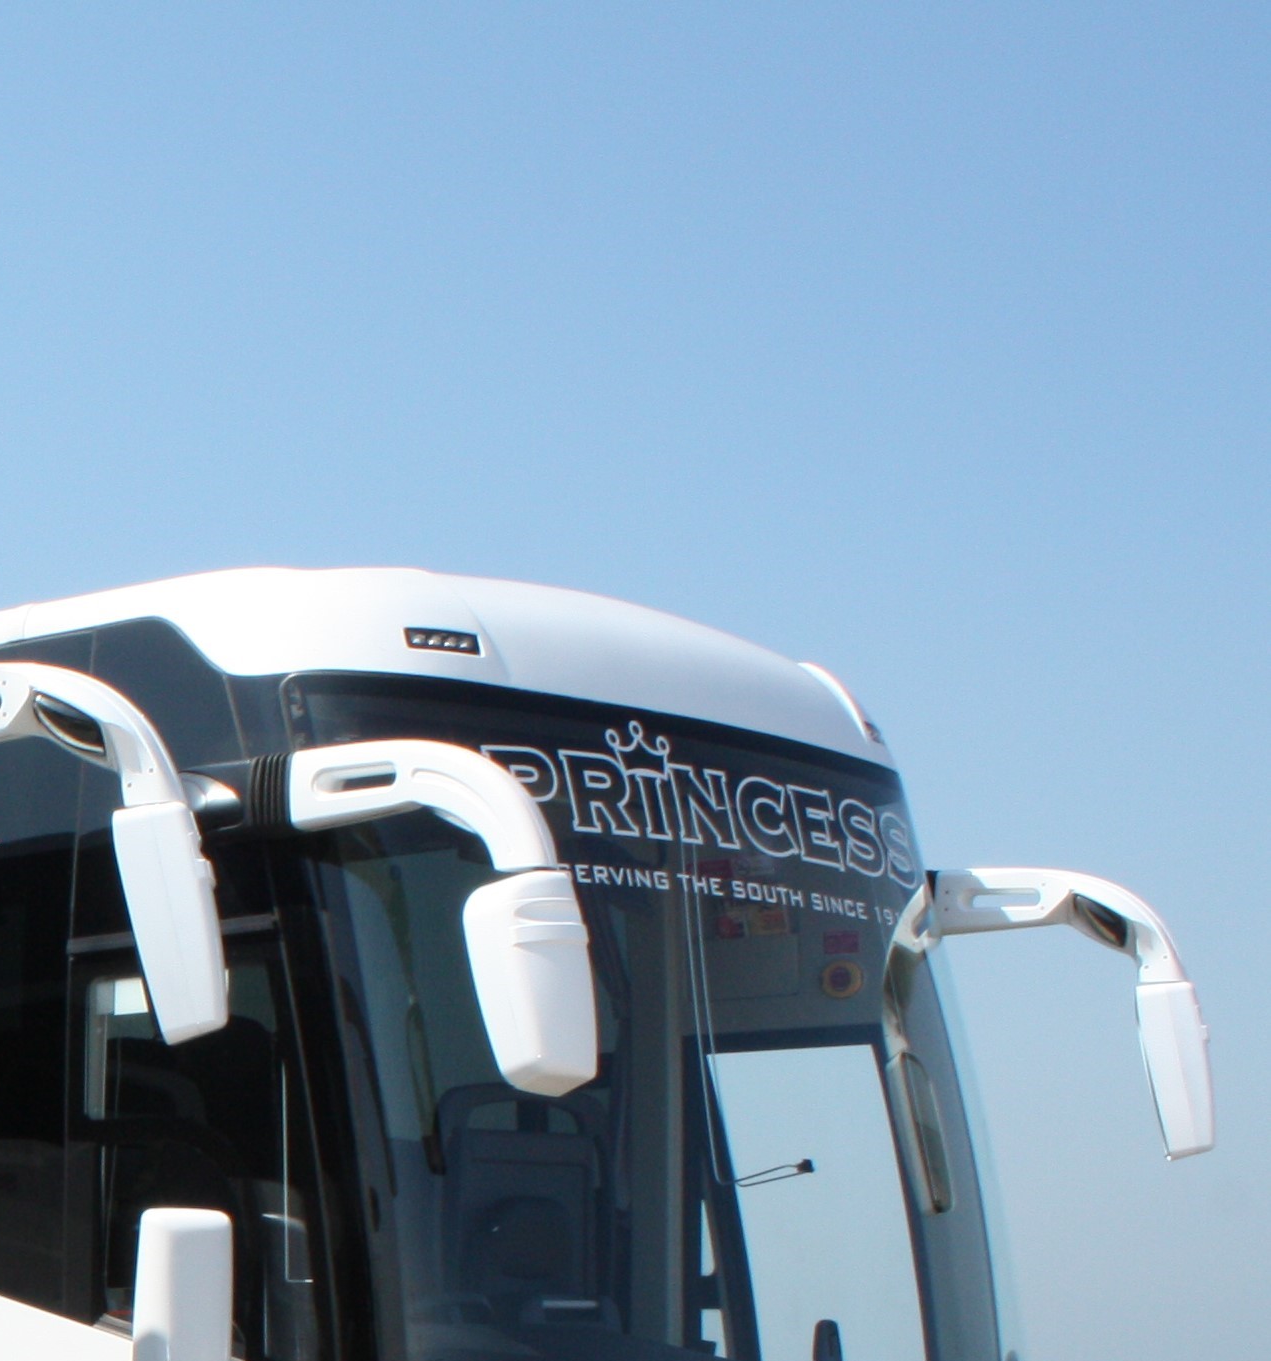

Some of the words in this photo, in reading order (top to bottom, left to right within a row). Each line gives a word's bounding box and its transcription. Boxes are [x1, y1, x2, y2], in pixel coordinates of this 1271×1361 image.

[558, 863, 670, 890] ERVING
[676, 872, 725, 897] THE
[731, 879, 805, 908] SOUTH
[811, 892, 868, 920] SINCE
